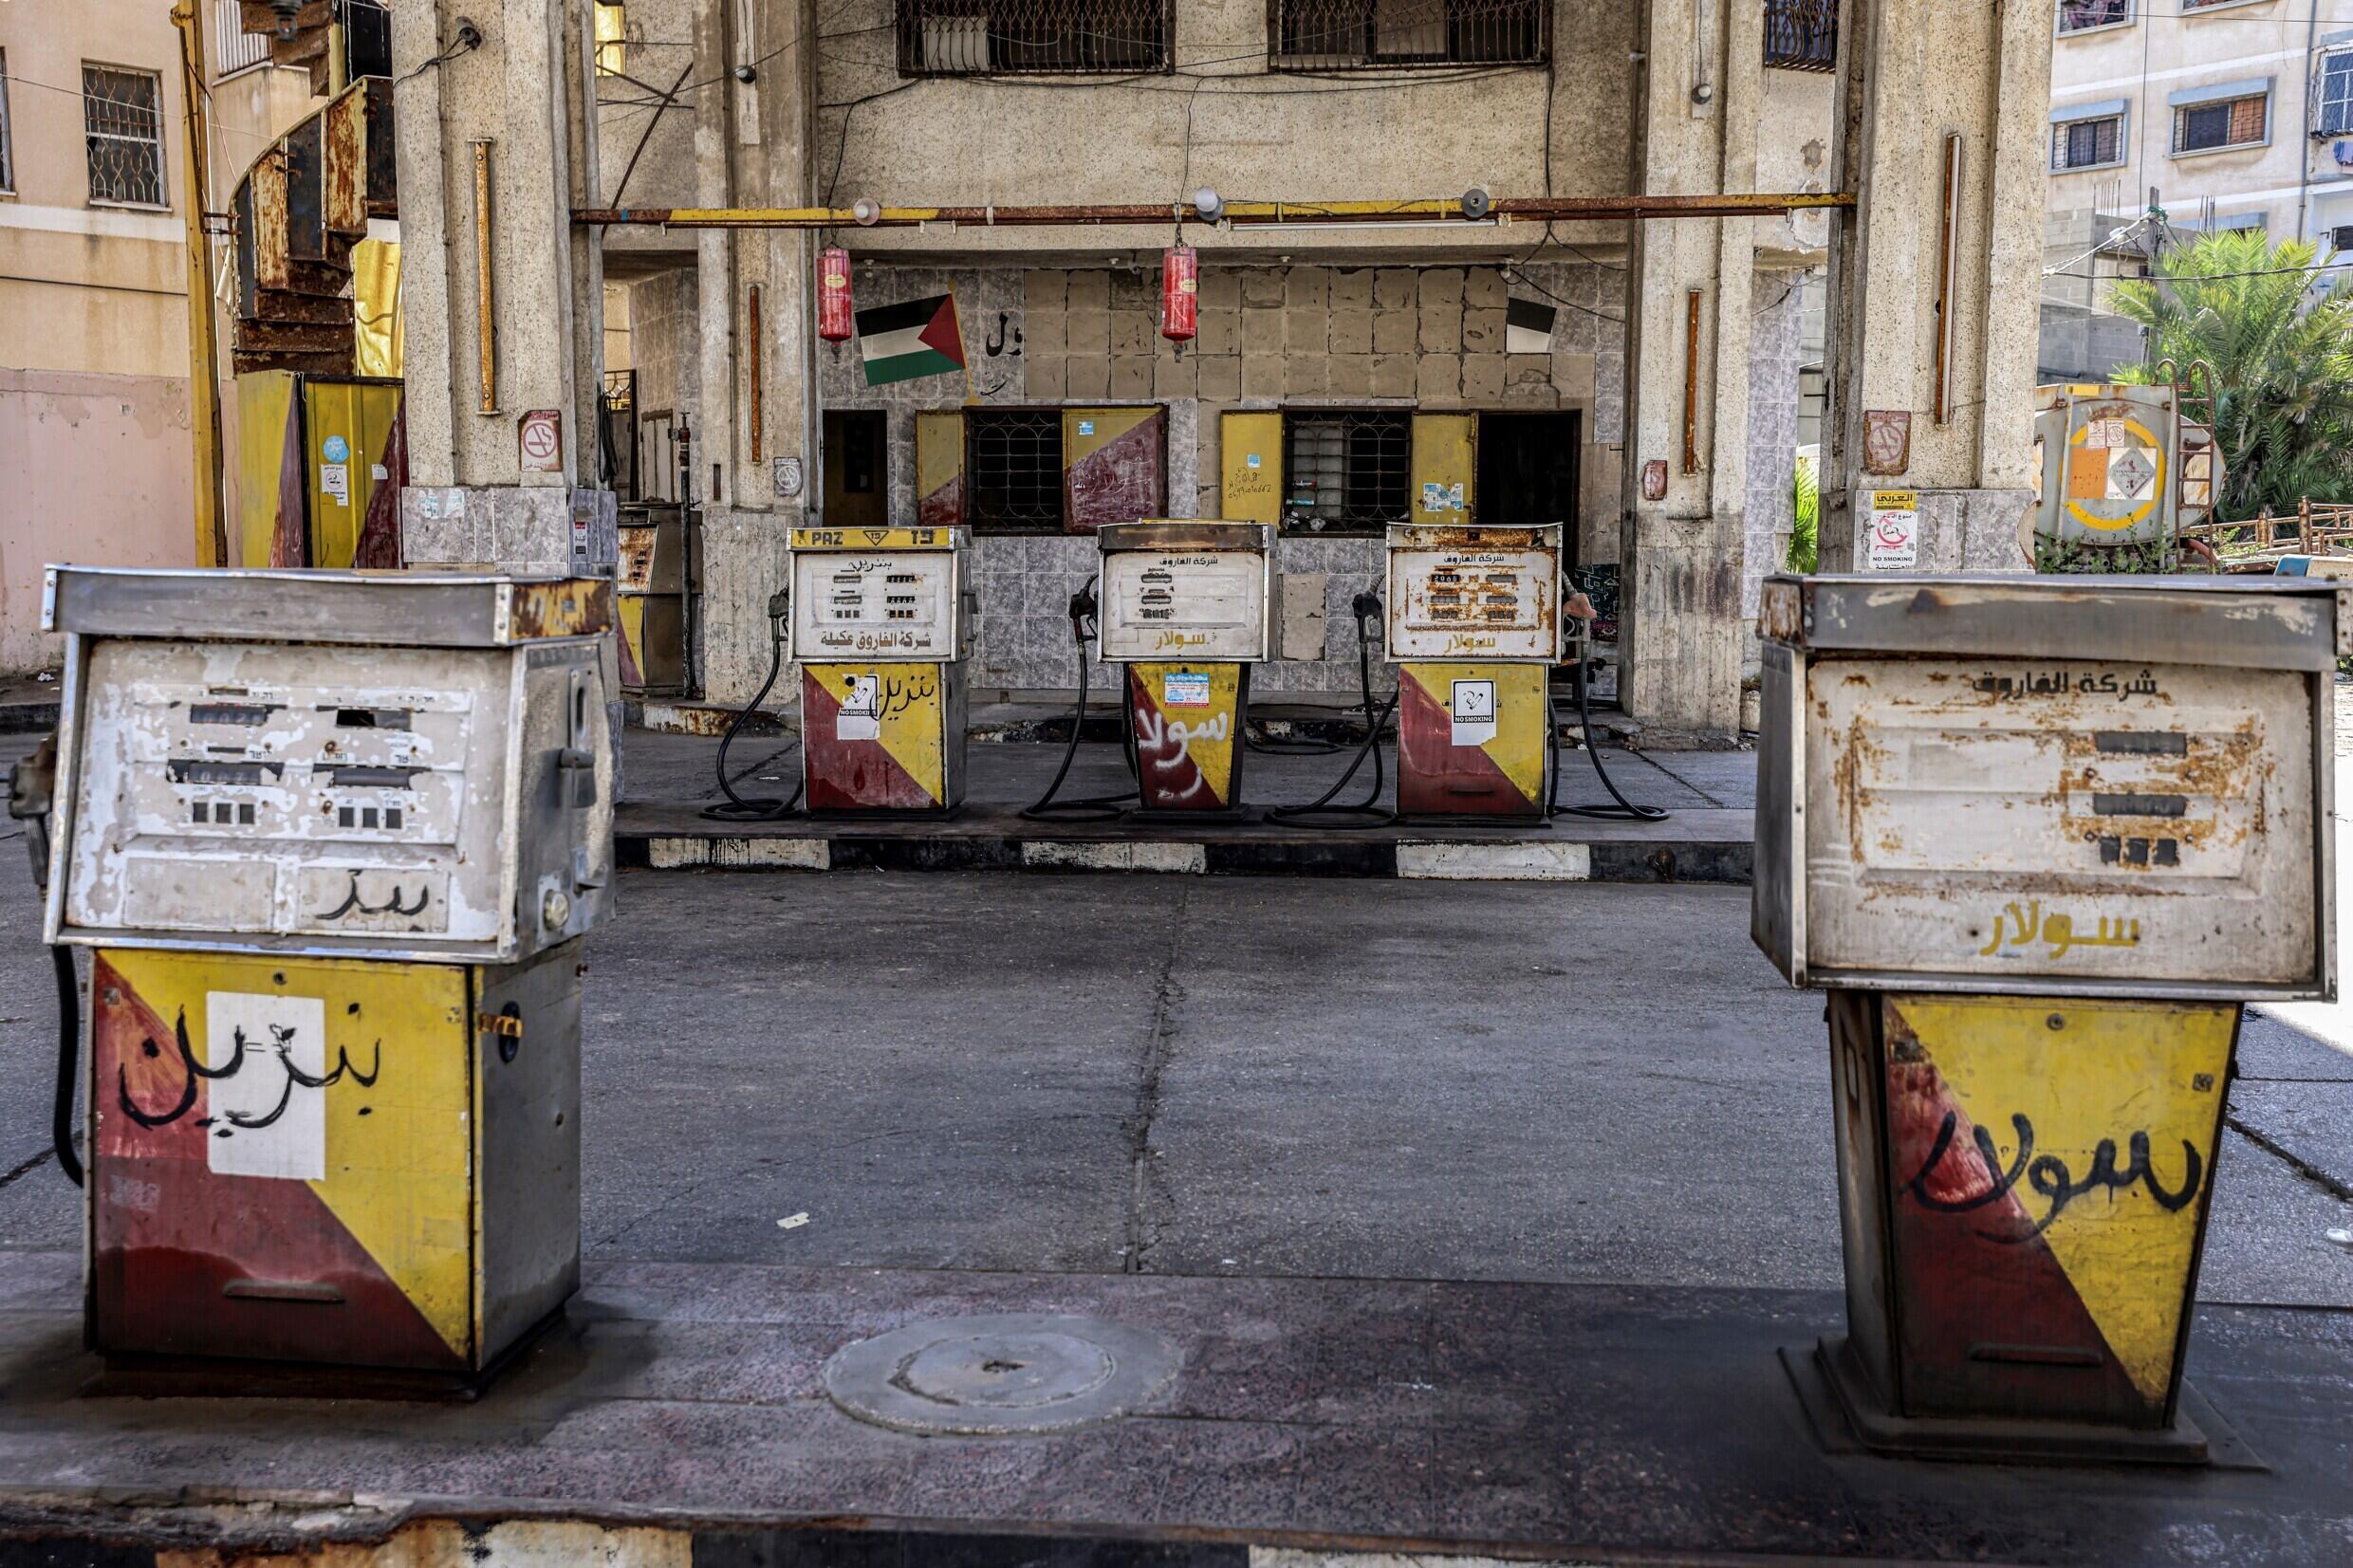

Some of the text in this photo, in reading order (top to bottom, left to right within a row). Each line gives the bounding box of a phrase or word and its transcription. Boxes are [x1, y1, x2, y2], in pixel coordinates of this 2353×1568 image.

[811, 531, 843, 545] PAZ
[1194, 555, 1218, 566] شركة
[1478, 554, 1505, 564] شركة
[899, 630, 932, 651] شركة
[1155, 630, 1206, 651] سولار
[1444, 634, 1496, 654] سولار
[1972, 669, 2157, 702] شركة الفاروق
[1979, 900, 2140, 961] سولار
